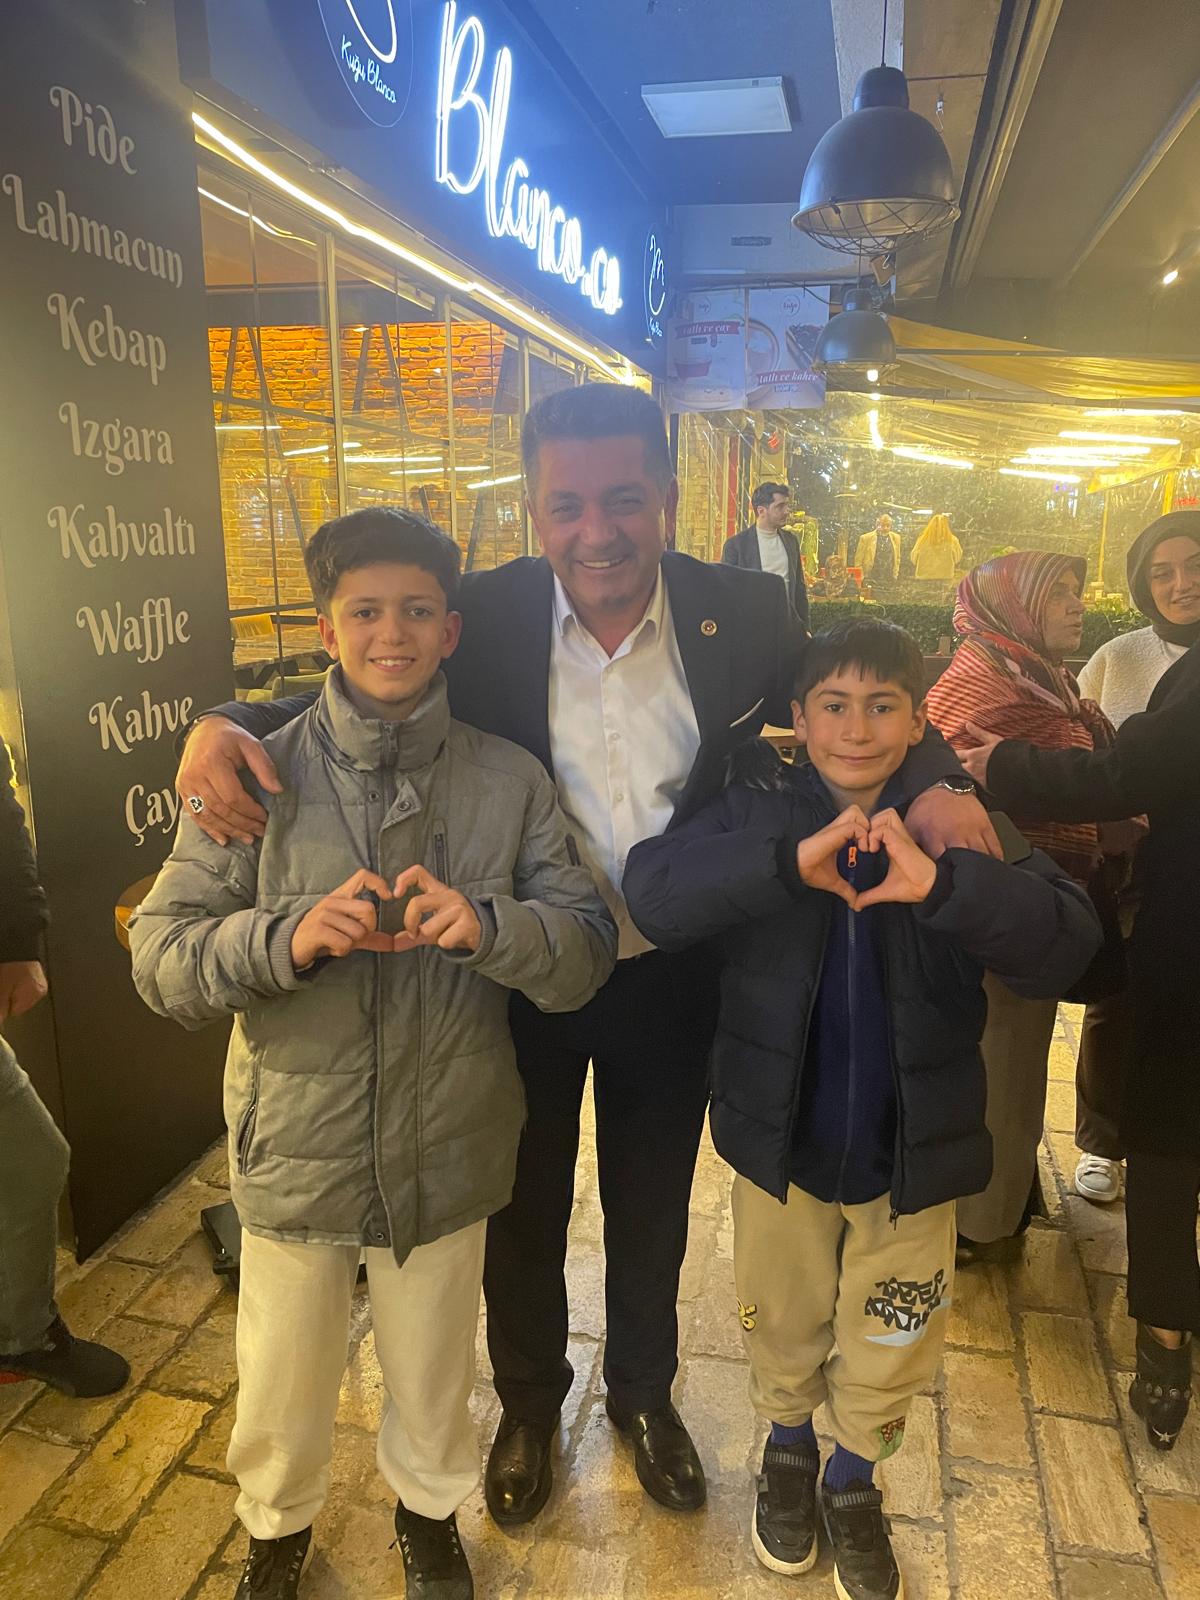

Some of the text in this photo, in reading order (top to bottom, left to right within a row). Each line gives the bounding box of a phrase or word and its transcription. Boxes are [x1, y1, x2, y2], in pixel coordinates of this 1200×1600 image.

[367, 58, 397, 103] Blanco
[50, 86, 137, 175] Pide
[2, 174, 183, 288] Lahmacun
[47, 293, 167, 386] Kebap
[58, 401, 174, 476] Izgara
[47, 503, 195, 569] Kahvaltı
[76, 597, 191, 664] Waffle
[88, 690, 193, 754] Kahve
[125, 784, 180, 847] Çay
